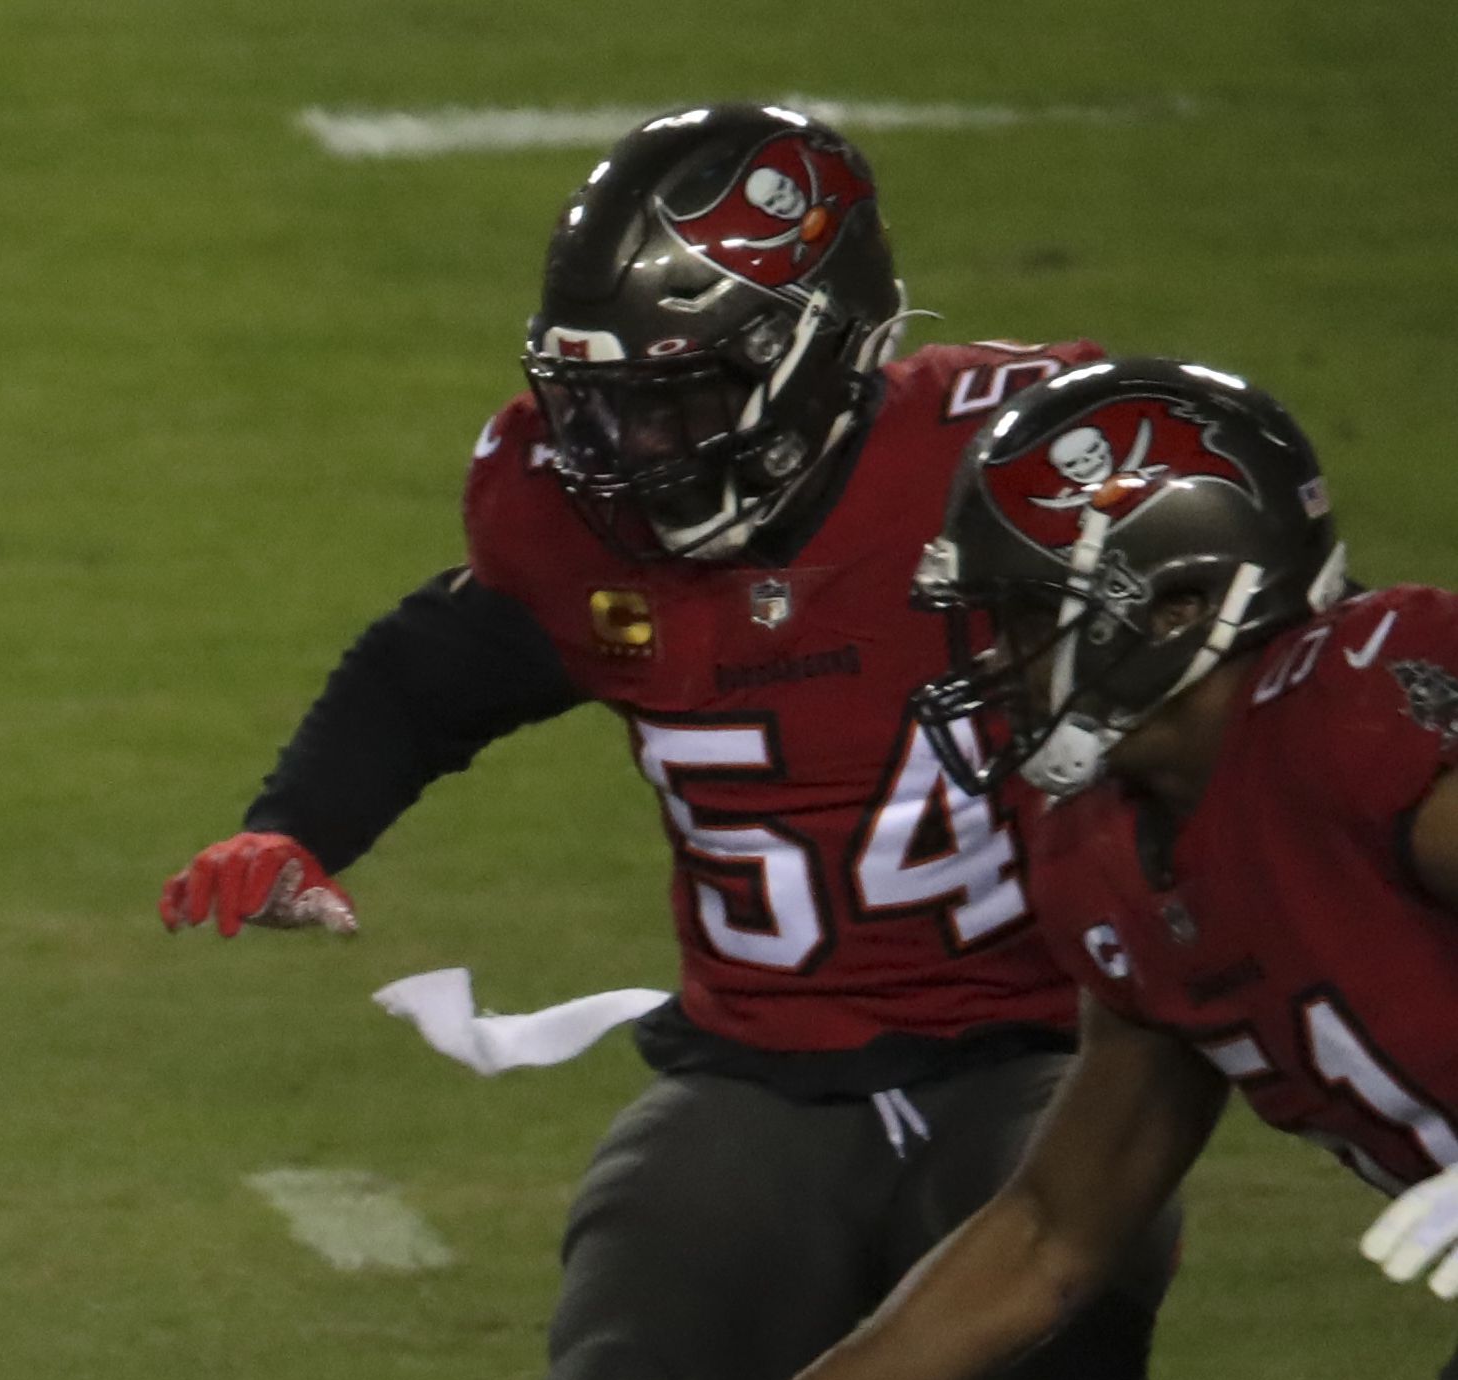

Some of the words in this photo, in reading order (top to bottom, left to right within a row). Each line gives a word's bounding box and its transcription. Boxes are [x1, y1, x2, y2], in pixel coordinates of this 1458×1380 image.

[589, 590, 653, 645] C
[637, 710, 1027, 974] 54
[1084, 924, 1130, 980] C
